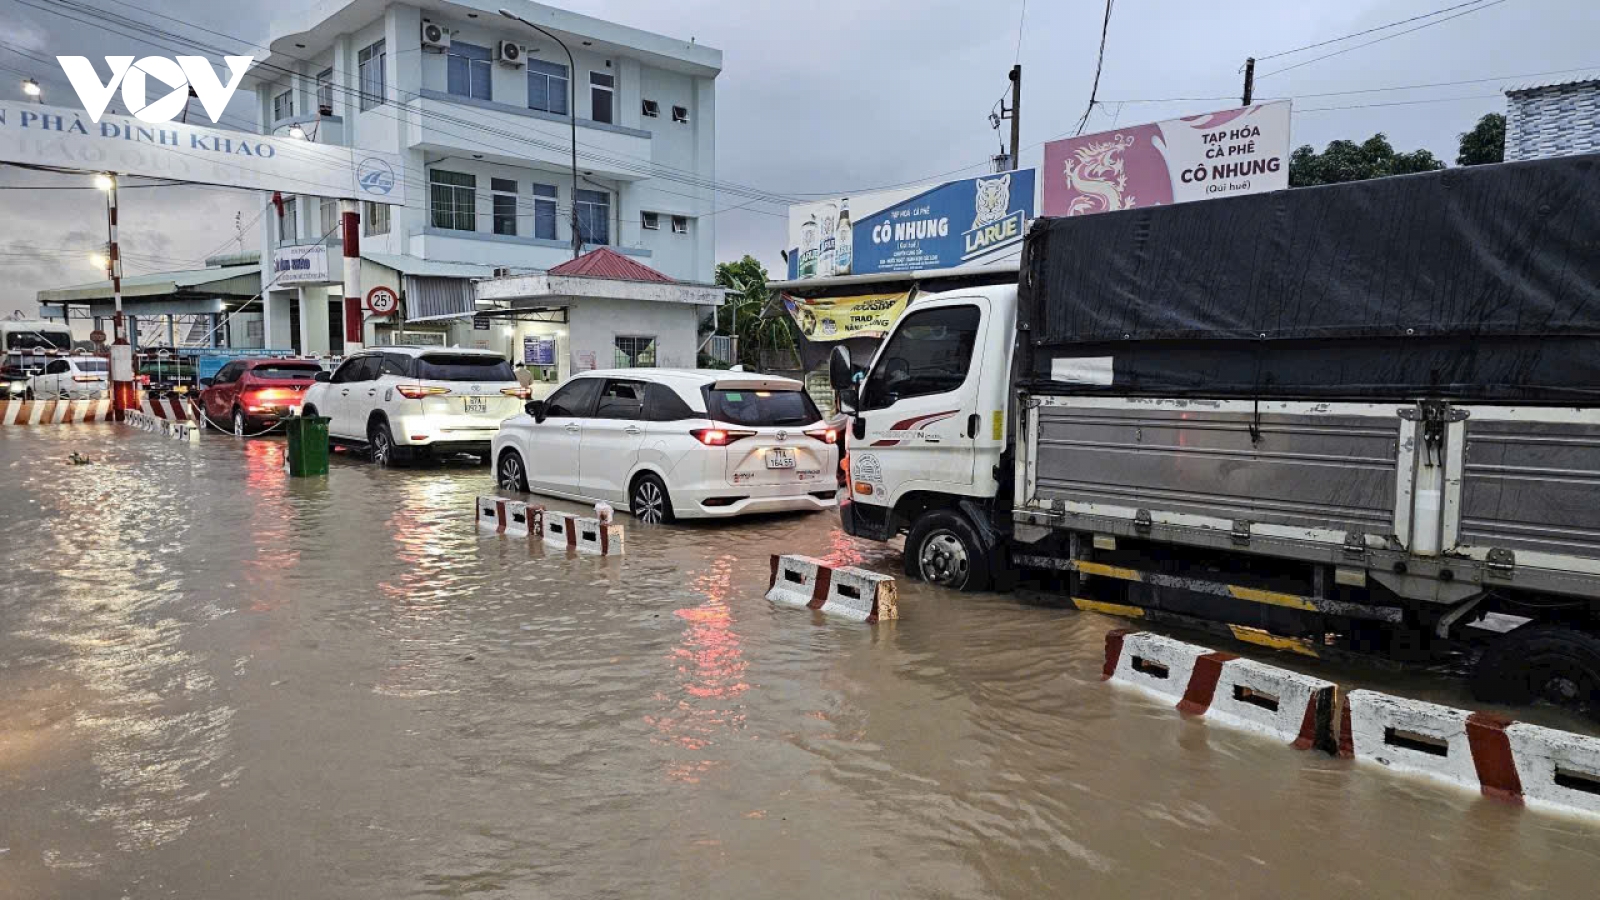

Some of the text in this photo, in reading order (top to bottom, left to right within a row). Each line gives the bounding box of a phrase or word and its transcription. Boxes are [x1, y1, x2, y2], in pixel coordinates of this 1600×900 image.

[20, 112, 90, 135] PHÀ
[100, 119, 179, 147] ĐÌNH
[190, 133, 276, 159] KHAO
[1202, 125, 1260, 146] TẠP HÓA
[1205, 140, 1255, 159] CÀ PHÊ
[1181, 157, 1280, 183] CÔ NHUNG
[872, 217, 949, 244] CÔ NHUNG
[965, 216, 1018, 253] LARUE
